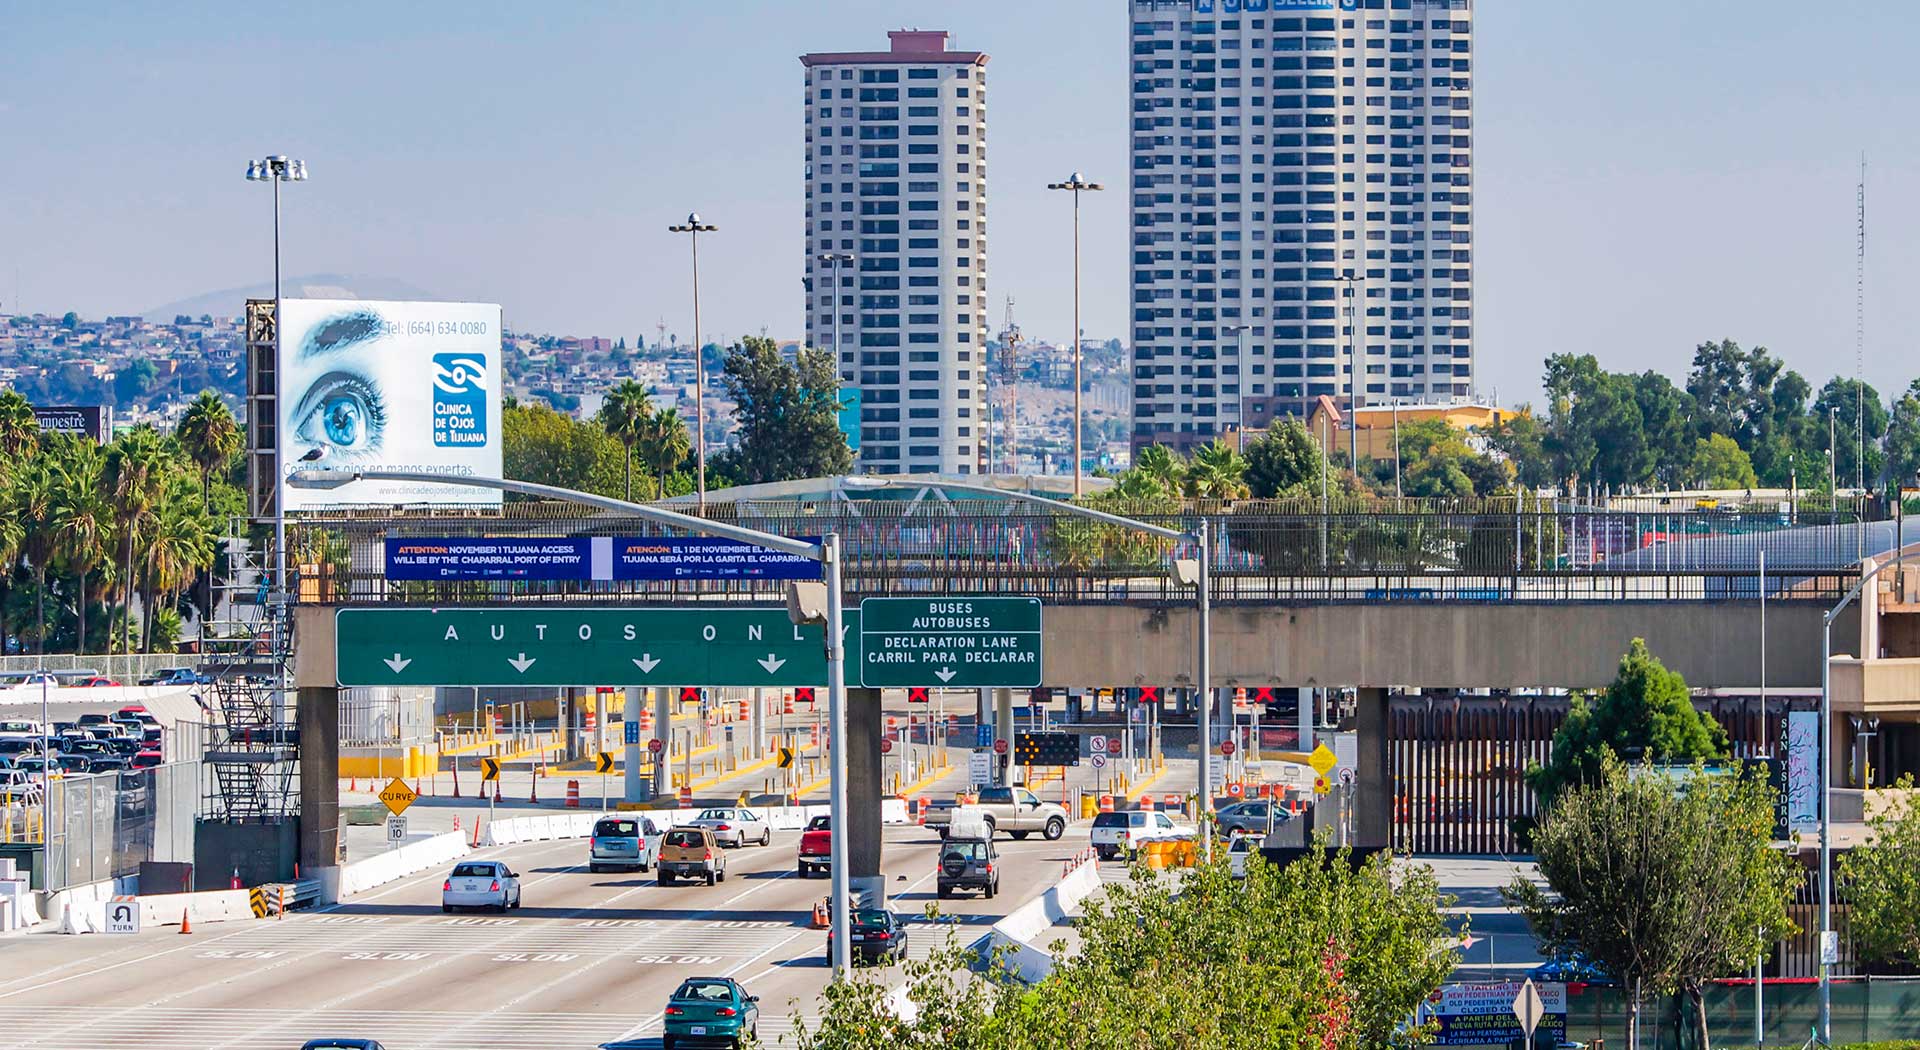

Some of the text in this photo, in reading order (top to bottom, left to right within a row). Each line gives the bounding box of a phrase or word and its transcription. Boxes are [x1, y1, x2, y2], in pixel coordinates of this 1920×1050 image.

[1199, 0, 1263, 8] NOW
[386, 320, 487, 336] Tel: (664) 634 0080
[36, 413, 85, 428] ampestre
[435, 418, 447, 429] DE
[435, 430, 486, 442] DE TIJUANA
[378, 486, 493, 498] www.clinicadeojosdetijuana.com
[399, 546, 574, 554] ATTENTION: NOVEMBER 1 TIJUANA ACCESS
[626, 545, 671, 554] ATENCIÓN:
[672, 546, 683, 554] EL
[684, 546, 689, 554] 1
[690, 546, 701, 554] DE
[702, 546, 751, 554] NOVIEMBRE
[752, 546, 763, 554] EL
[393, 556, 581, 564] WILL BE BY THE CHAPARRAL PORT OF ENTRY
[622, 556, 659, 564] TIJUANA
[660, 554, 682, 563] SERÁ
[747, 555, 758, 563] EL
[759, 555, 811, 563] CHAPARRAL
[929, 603, 973, 614] BUSES
[912, 617, 990, 628] AUTOBUSES
[444, 624, 637, 641] AUTOS
[884, 637, 1018, 648] DECLARATION LANE
[868, 652, 1035, 663] CARRIL PARA DECLARAR
[1780, 718, 1788, 751] SAN
[382, 792, 413, 802] CURVE
[1780, 760, 1788, 827] YSIDRO
[392, 829, 402, 839] 10
[195, 951, 288, 959] SLOW
[342, 952, 433, 960] SLOW
[491, 953, 579, 962] SLOW
[635, 955, 723, 964] SLOW
[1464, 983, 1510, 992] STARTING
[1448, 991, 1464, 999] NEW
[1464, 991, 1506, 999] PEDESTRIAN
[1464, 999, 1505, 1007] PEDESTRIAN
[1463, 1014, 1494, 1022] PARTIR
[1450, 1022, 1473, 1030] NUEVA
[1474, 1021, 1492, 1029] RUTA
[1459, 1029, 1476, 1037] RUTA
[1477, 1028, 1509, 1037] PEATONAL
[1448, 1037, 1485, 1046] CERRARA
